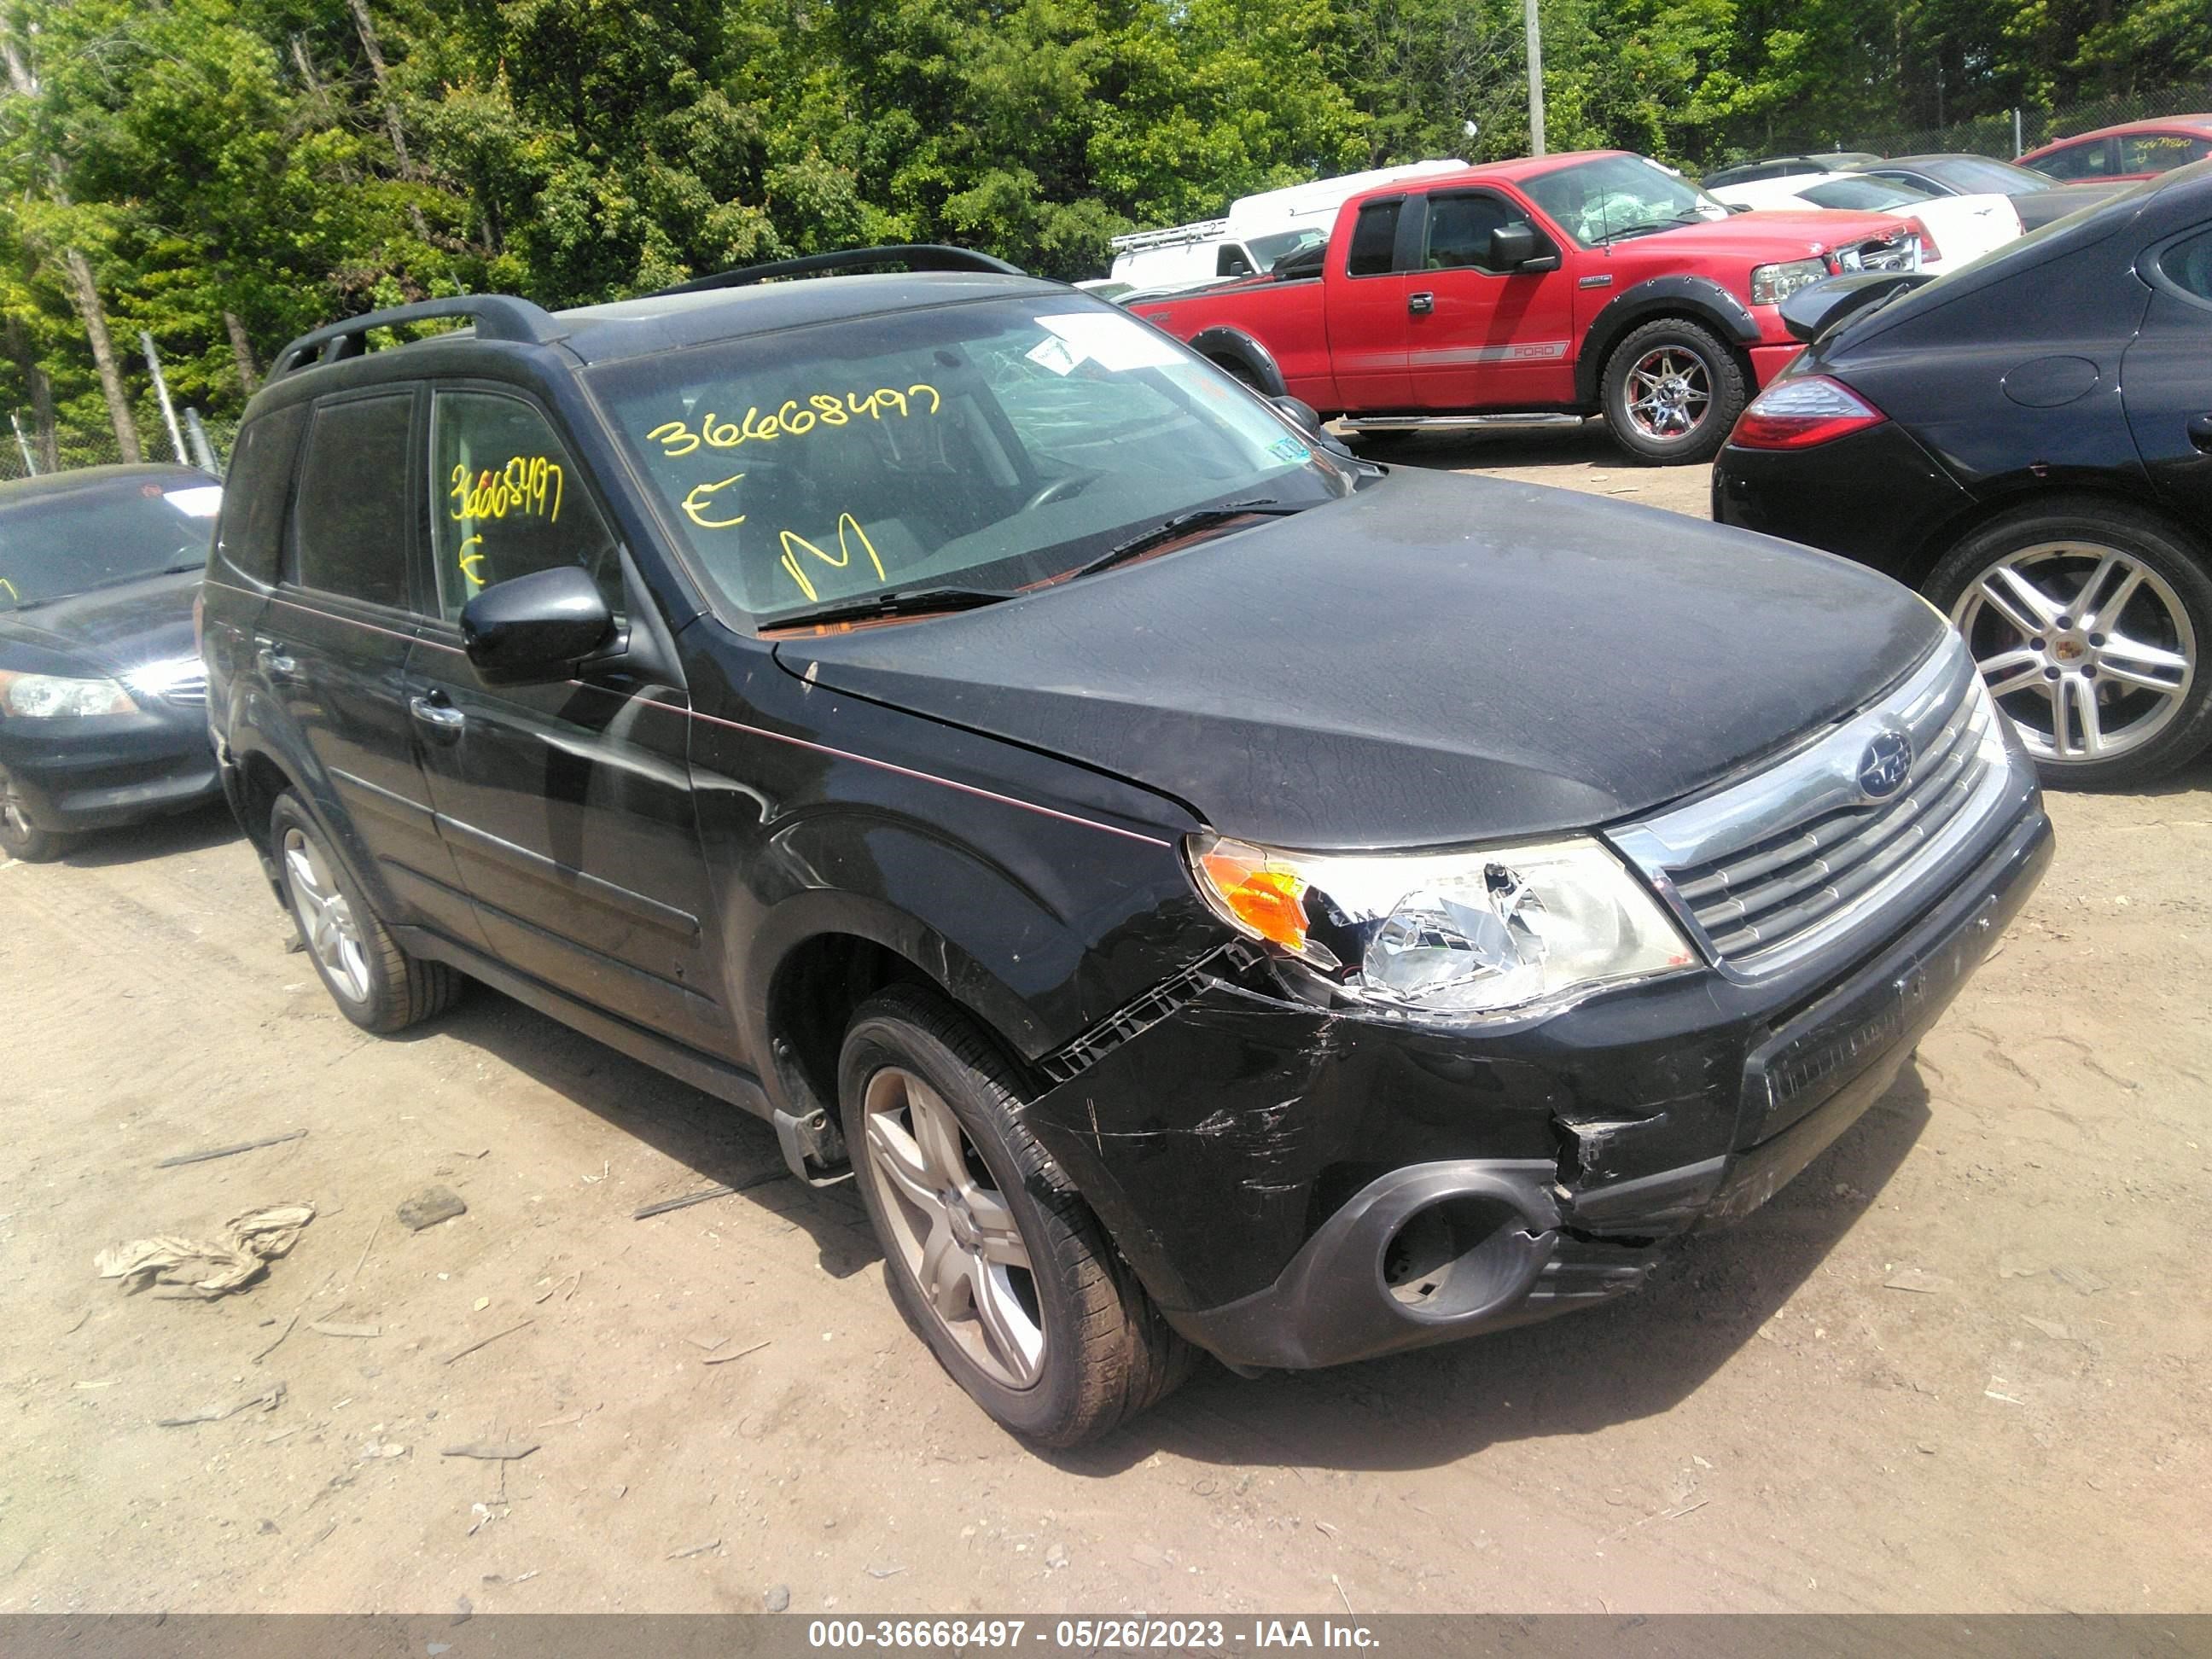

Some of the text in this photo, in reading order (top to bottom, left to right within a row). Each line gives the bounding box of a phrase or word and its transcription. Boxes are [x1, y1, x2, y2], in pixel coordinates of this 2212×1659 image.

[1514, 346, 1555, 356] FORD
[646, 384, 940, 456] 36668497
[450, 457, 562, 523] 36668497
[681, 473, 746, 528] E
[458, 533, 486, 585] E
[780, 512, 885, 602] M
